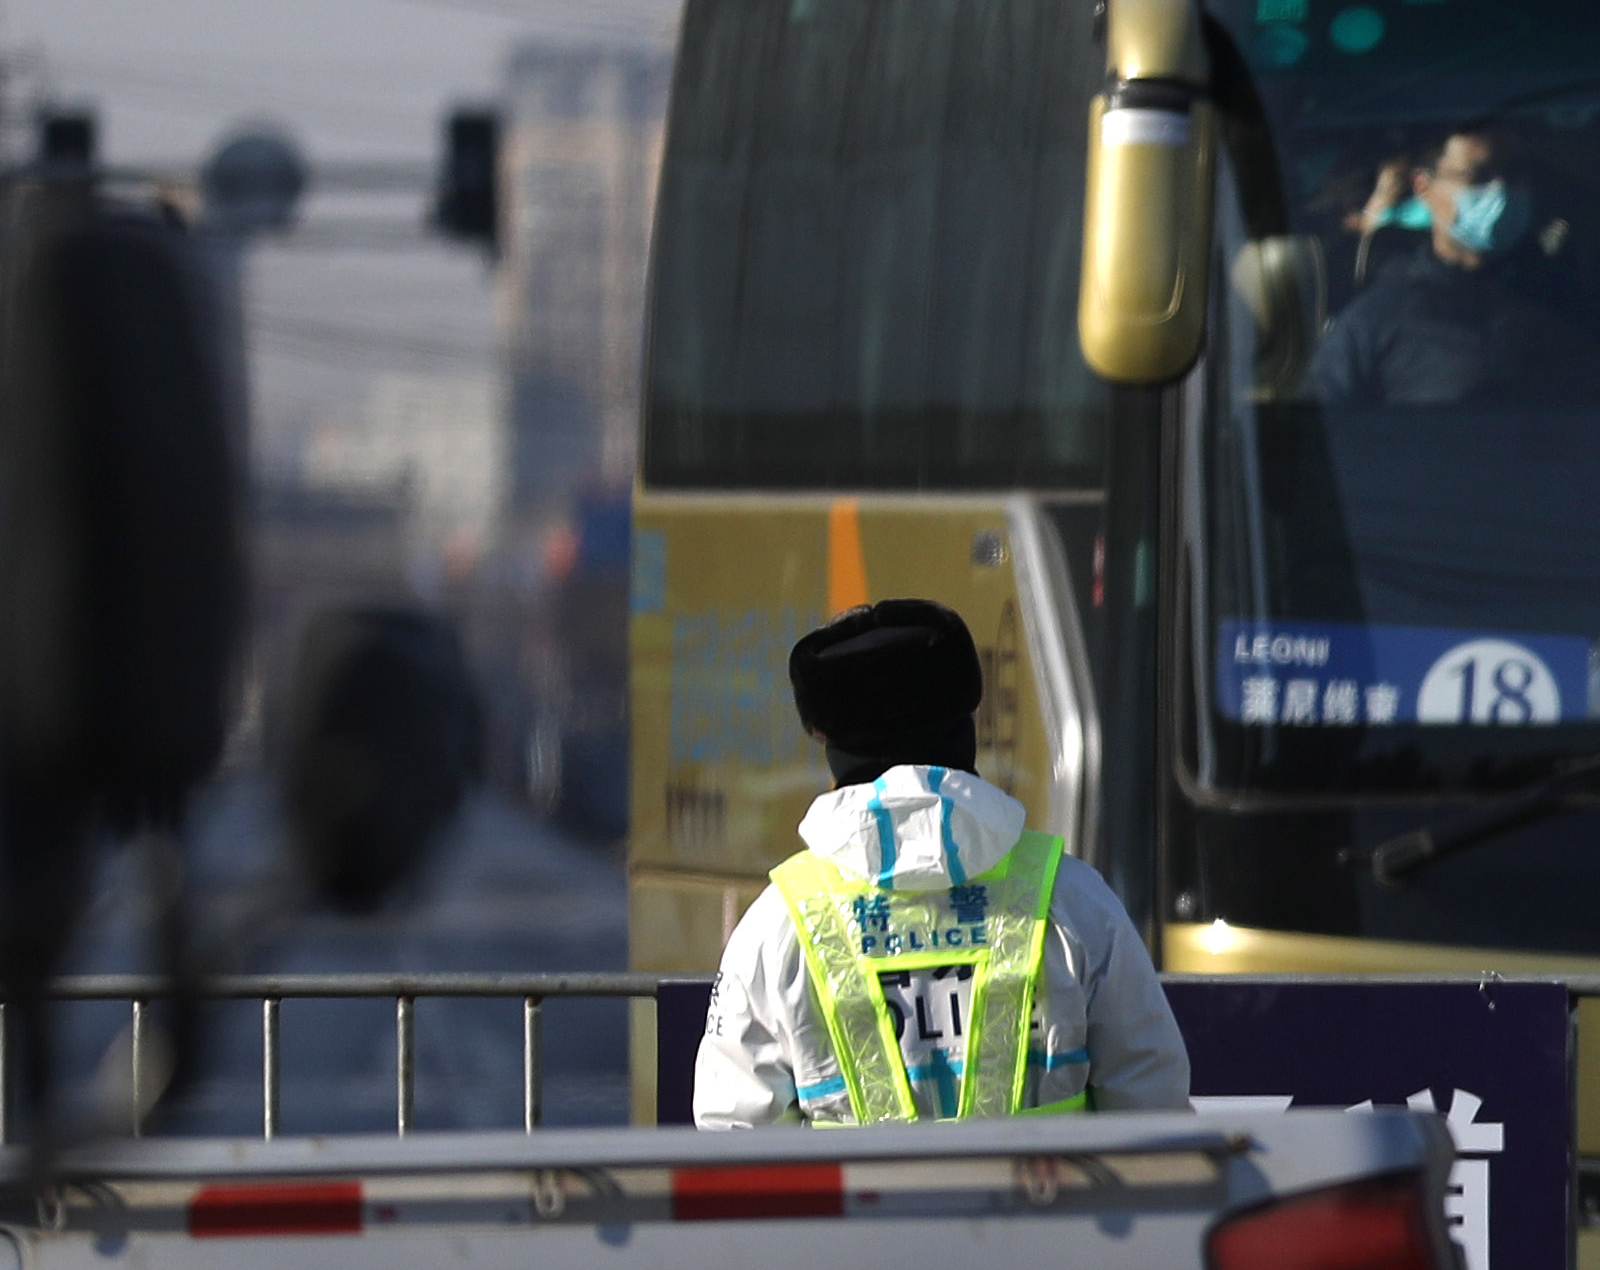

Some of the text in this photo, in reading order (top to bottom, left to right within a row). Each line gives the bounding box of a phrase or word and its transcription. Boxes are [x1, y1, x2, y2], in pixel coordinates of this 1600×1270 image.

[1449, 656, 1533, 726] 18
[853, 885, 988, 933] 特警
[861, 926, 988, 954] POLICE
